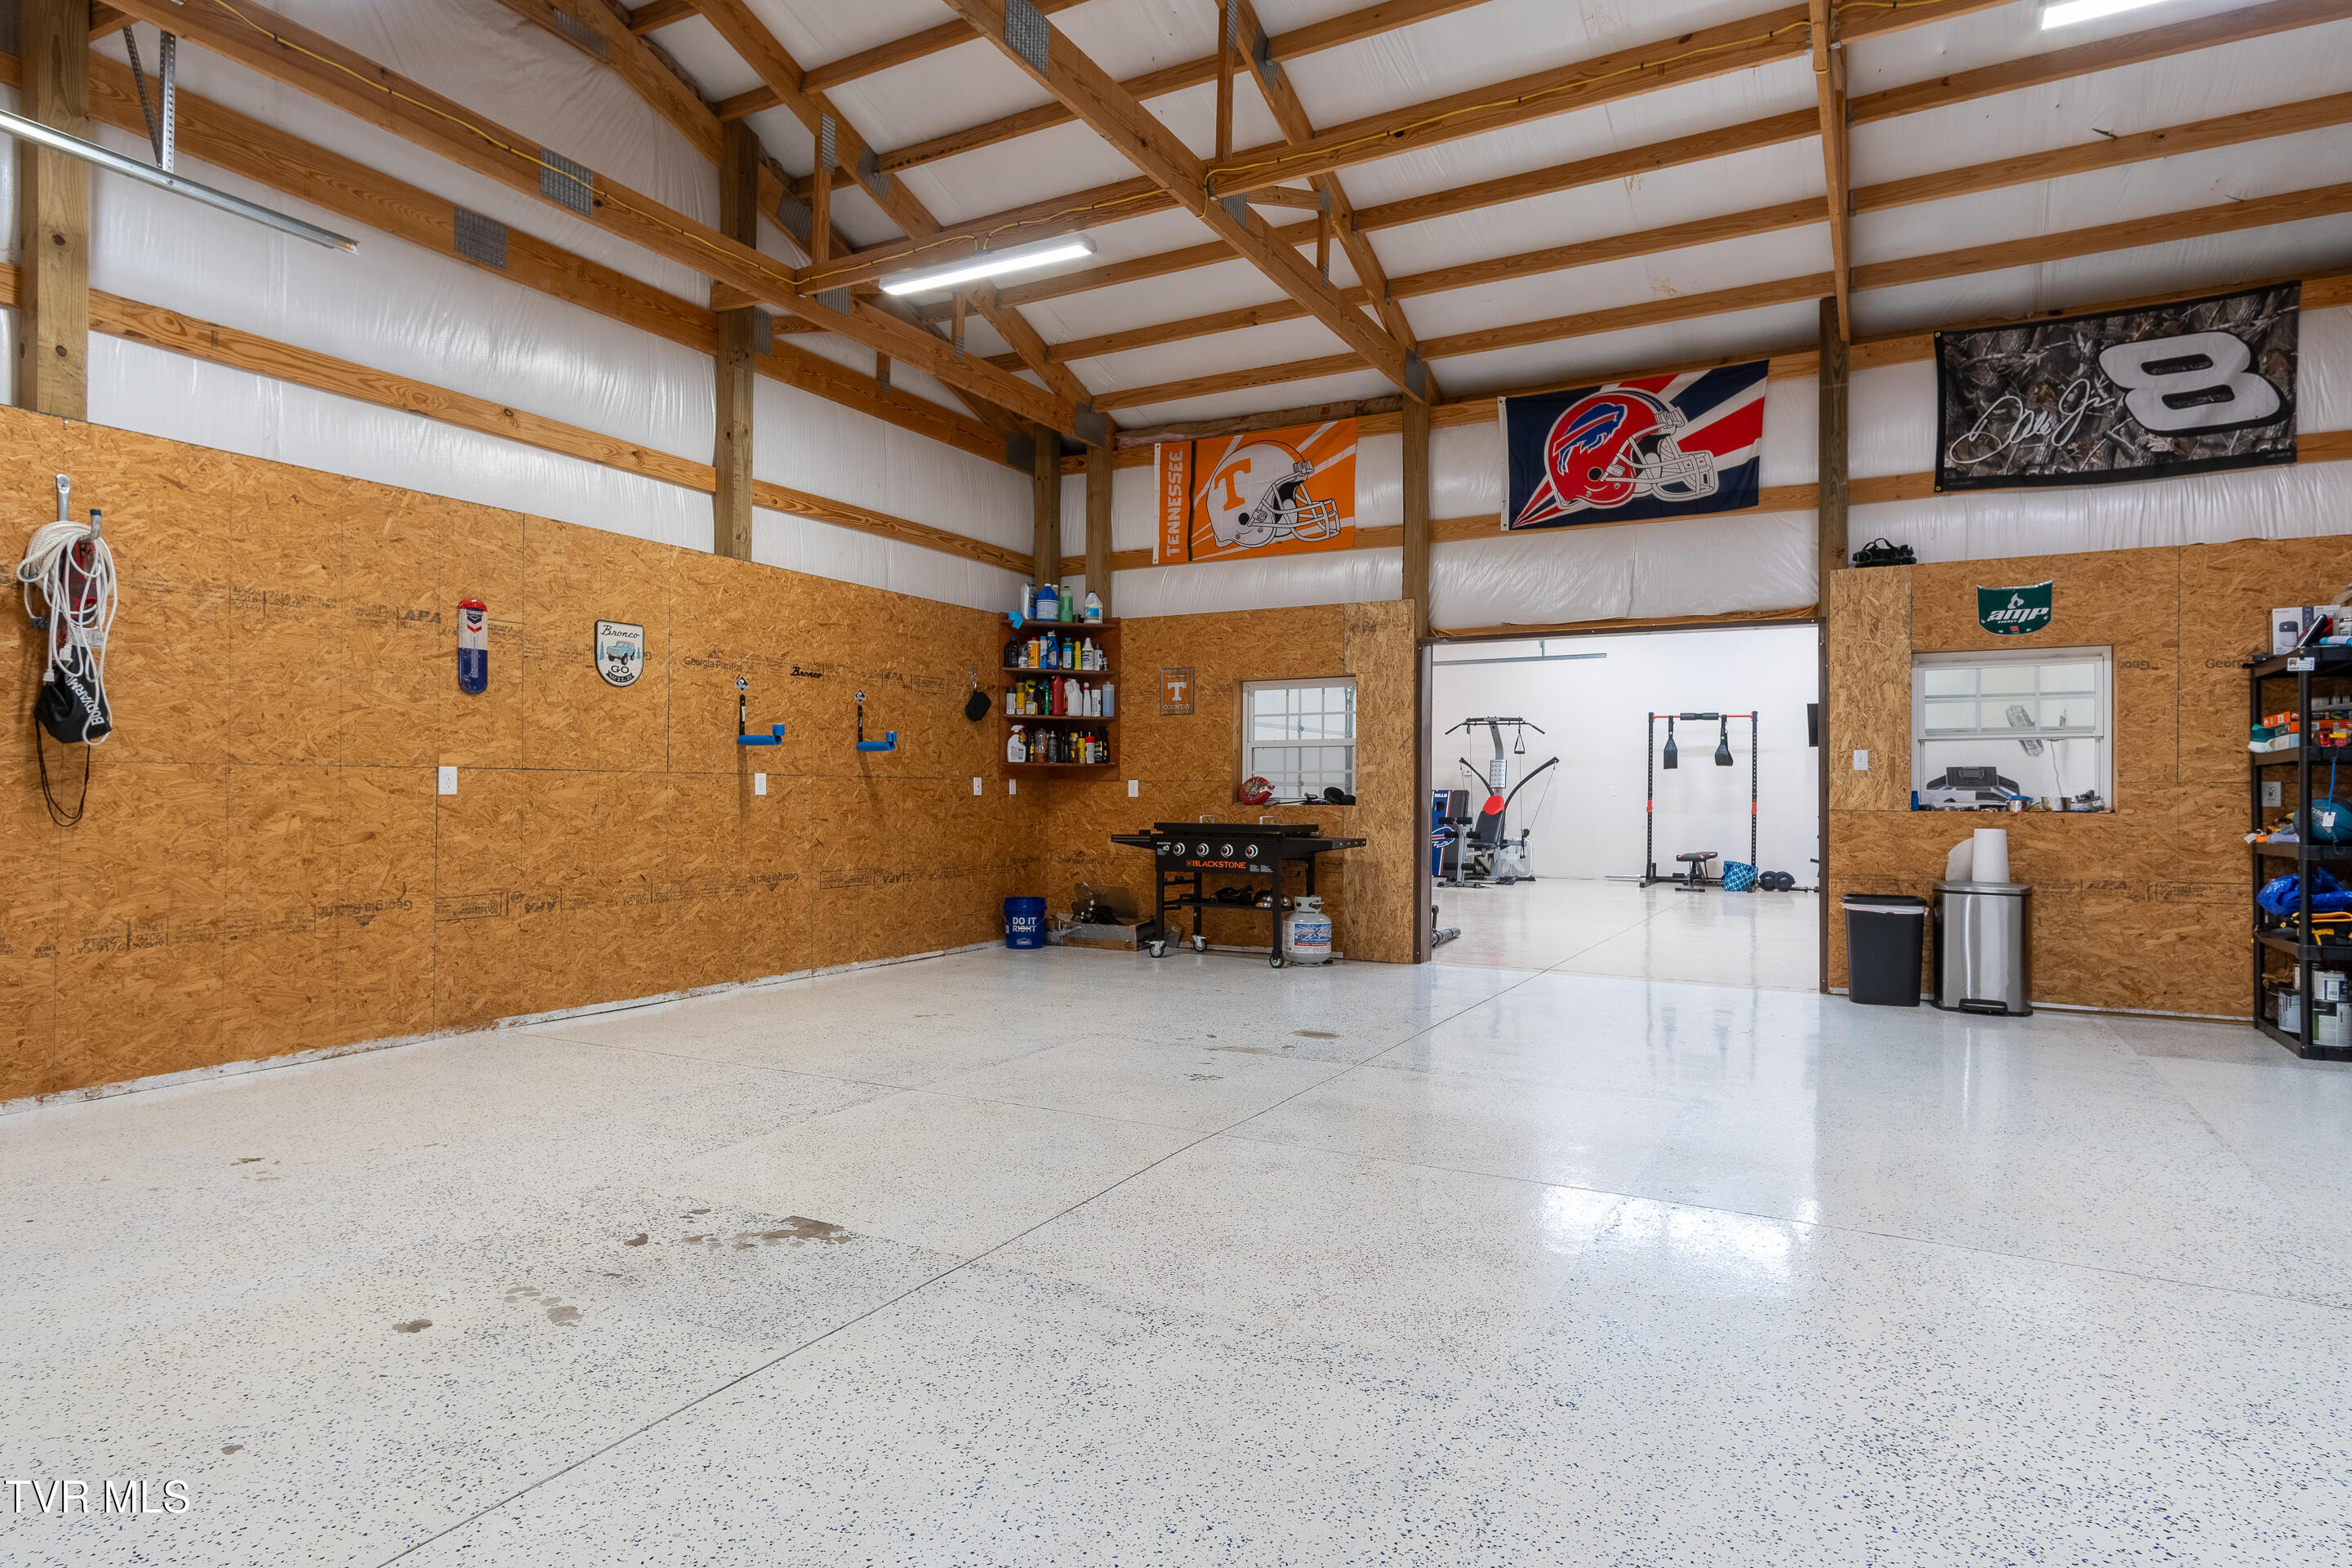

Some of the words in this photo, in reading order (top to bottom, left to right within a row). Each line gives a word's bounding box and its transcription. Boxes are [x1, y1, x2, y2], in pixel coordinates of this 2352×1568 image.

[2099, 331, 2282, 432] 8
[1214, 457, 1252, 512] T
[1166, 450, 1183, 557] TENNESSEE
[404, 609, 442, 624] APA
[600, 625, 641, 639] Bronco
[611, 665, 630, 674] GO
[790, 666, 823, 679] Bronco
[609, 673, 633, 683] WILD
[1167, 681, 1187, 702] T
[1192, 860, 1247, 869] BLACKSTONE
[1012, 916, 1026, 925] DO
[1027, 916, 1037, 925] IT
[1012, 924, 1037, 933] RIGHT
[72, 947, 92, 956] CAT
